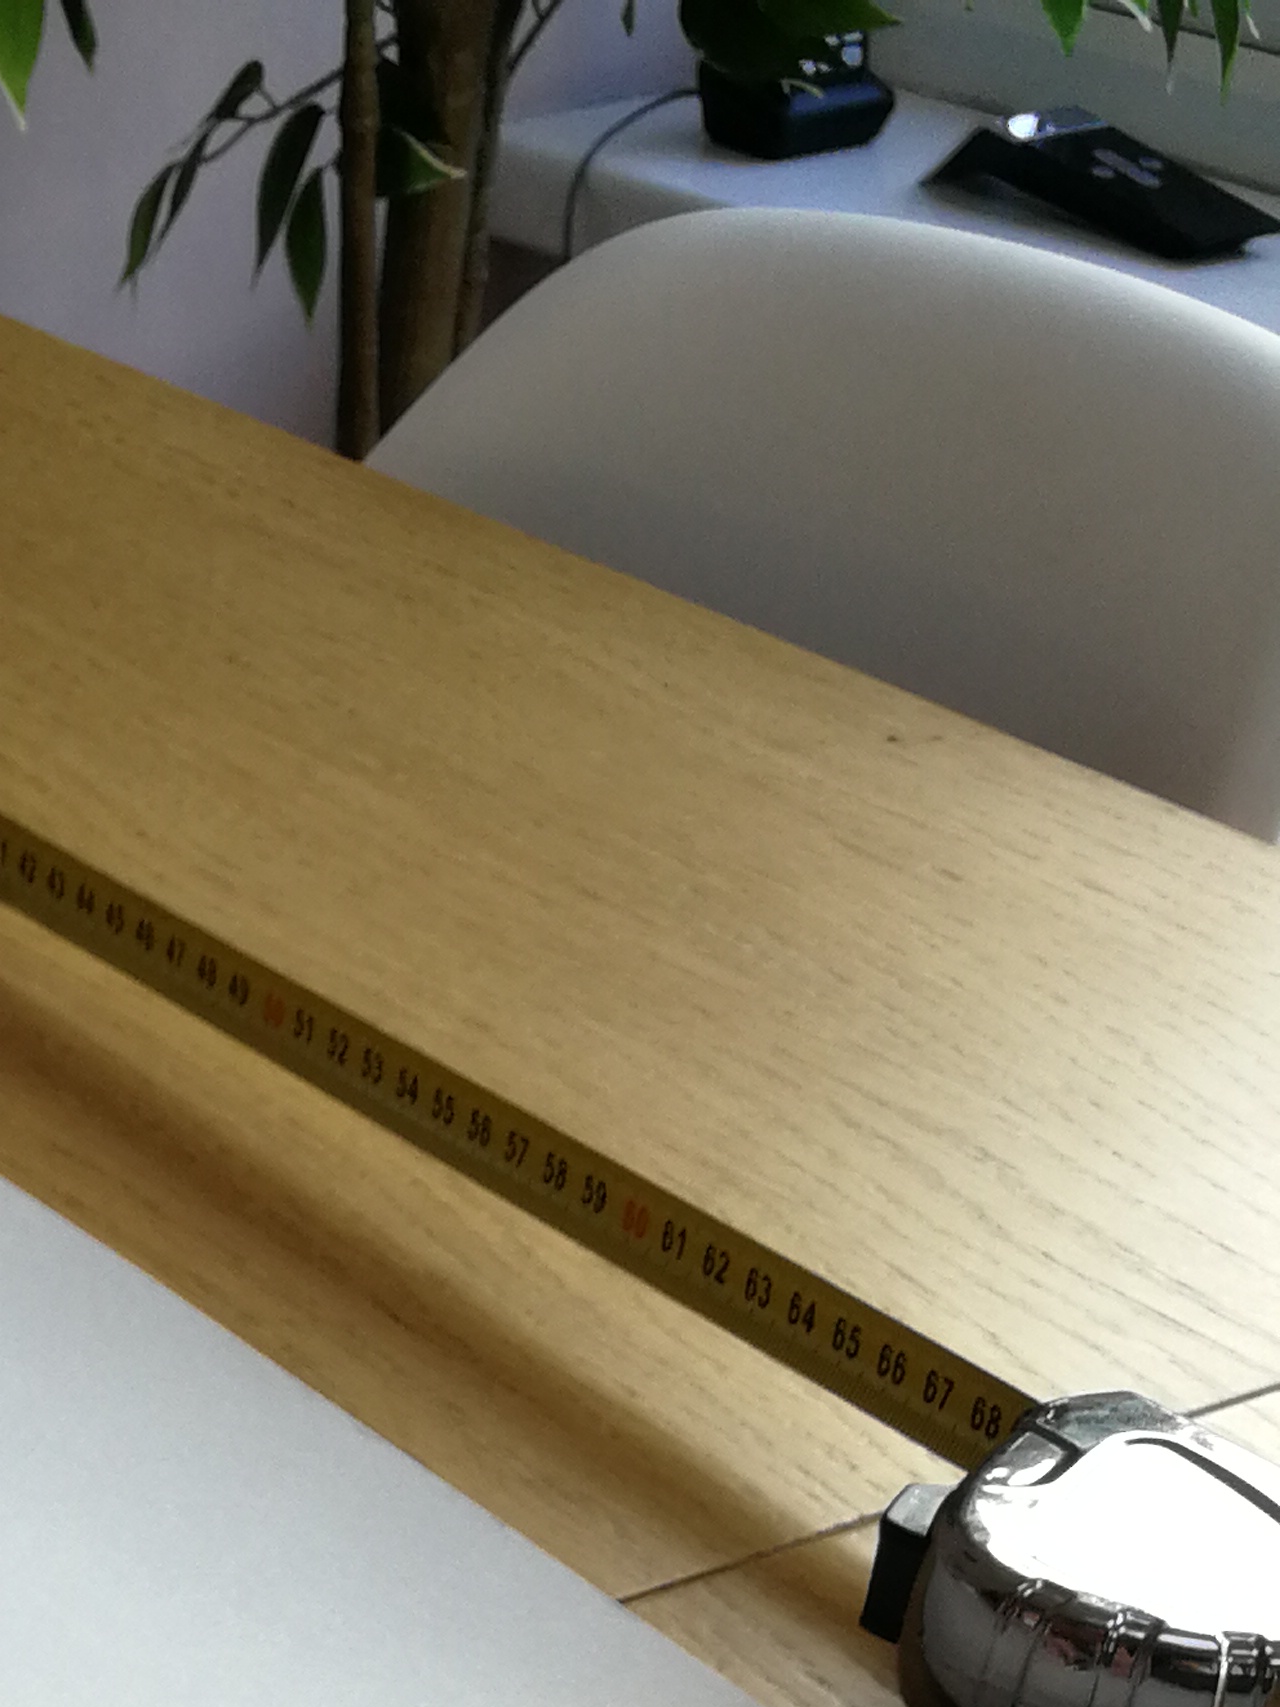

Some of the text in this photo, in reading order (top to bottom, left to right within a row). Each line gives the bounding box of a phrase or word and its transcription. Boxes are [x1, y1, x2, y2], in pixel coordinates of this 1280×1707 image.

[293, 1008, 314, 1044] 51
[327, 1027, 349, 1066] 52
[361, 1047, 384, 1085] 53
[396, 1066, 419, 1105] 54
[431, 1087, 455, 1125] 55
[467, 1109, 492, 1147] 56
[504, 1130, 530, 1168] 57
[542, 1151, 568, 1191] 58
[581, 1175, 607, 1214] 59
[661, 1219, 687, 1260] 61
[702, 1244, 730, 1284] 62
[744, 1267, 772, 1309] 63
[788, 1291, 816, 1335] 64
[831, 1317, 861, 1359] 65
[876, 1343, 906, 1386] 66
[922, 1369, 954, 1413] 67
[970, 1396, 1002, 1439] 68
